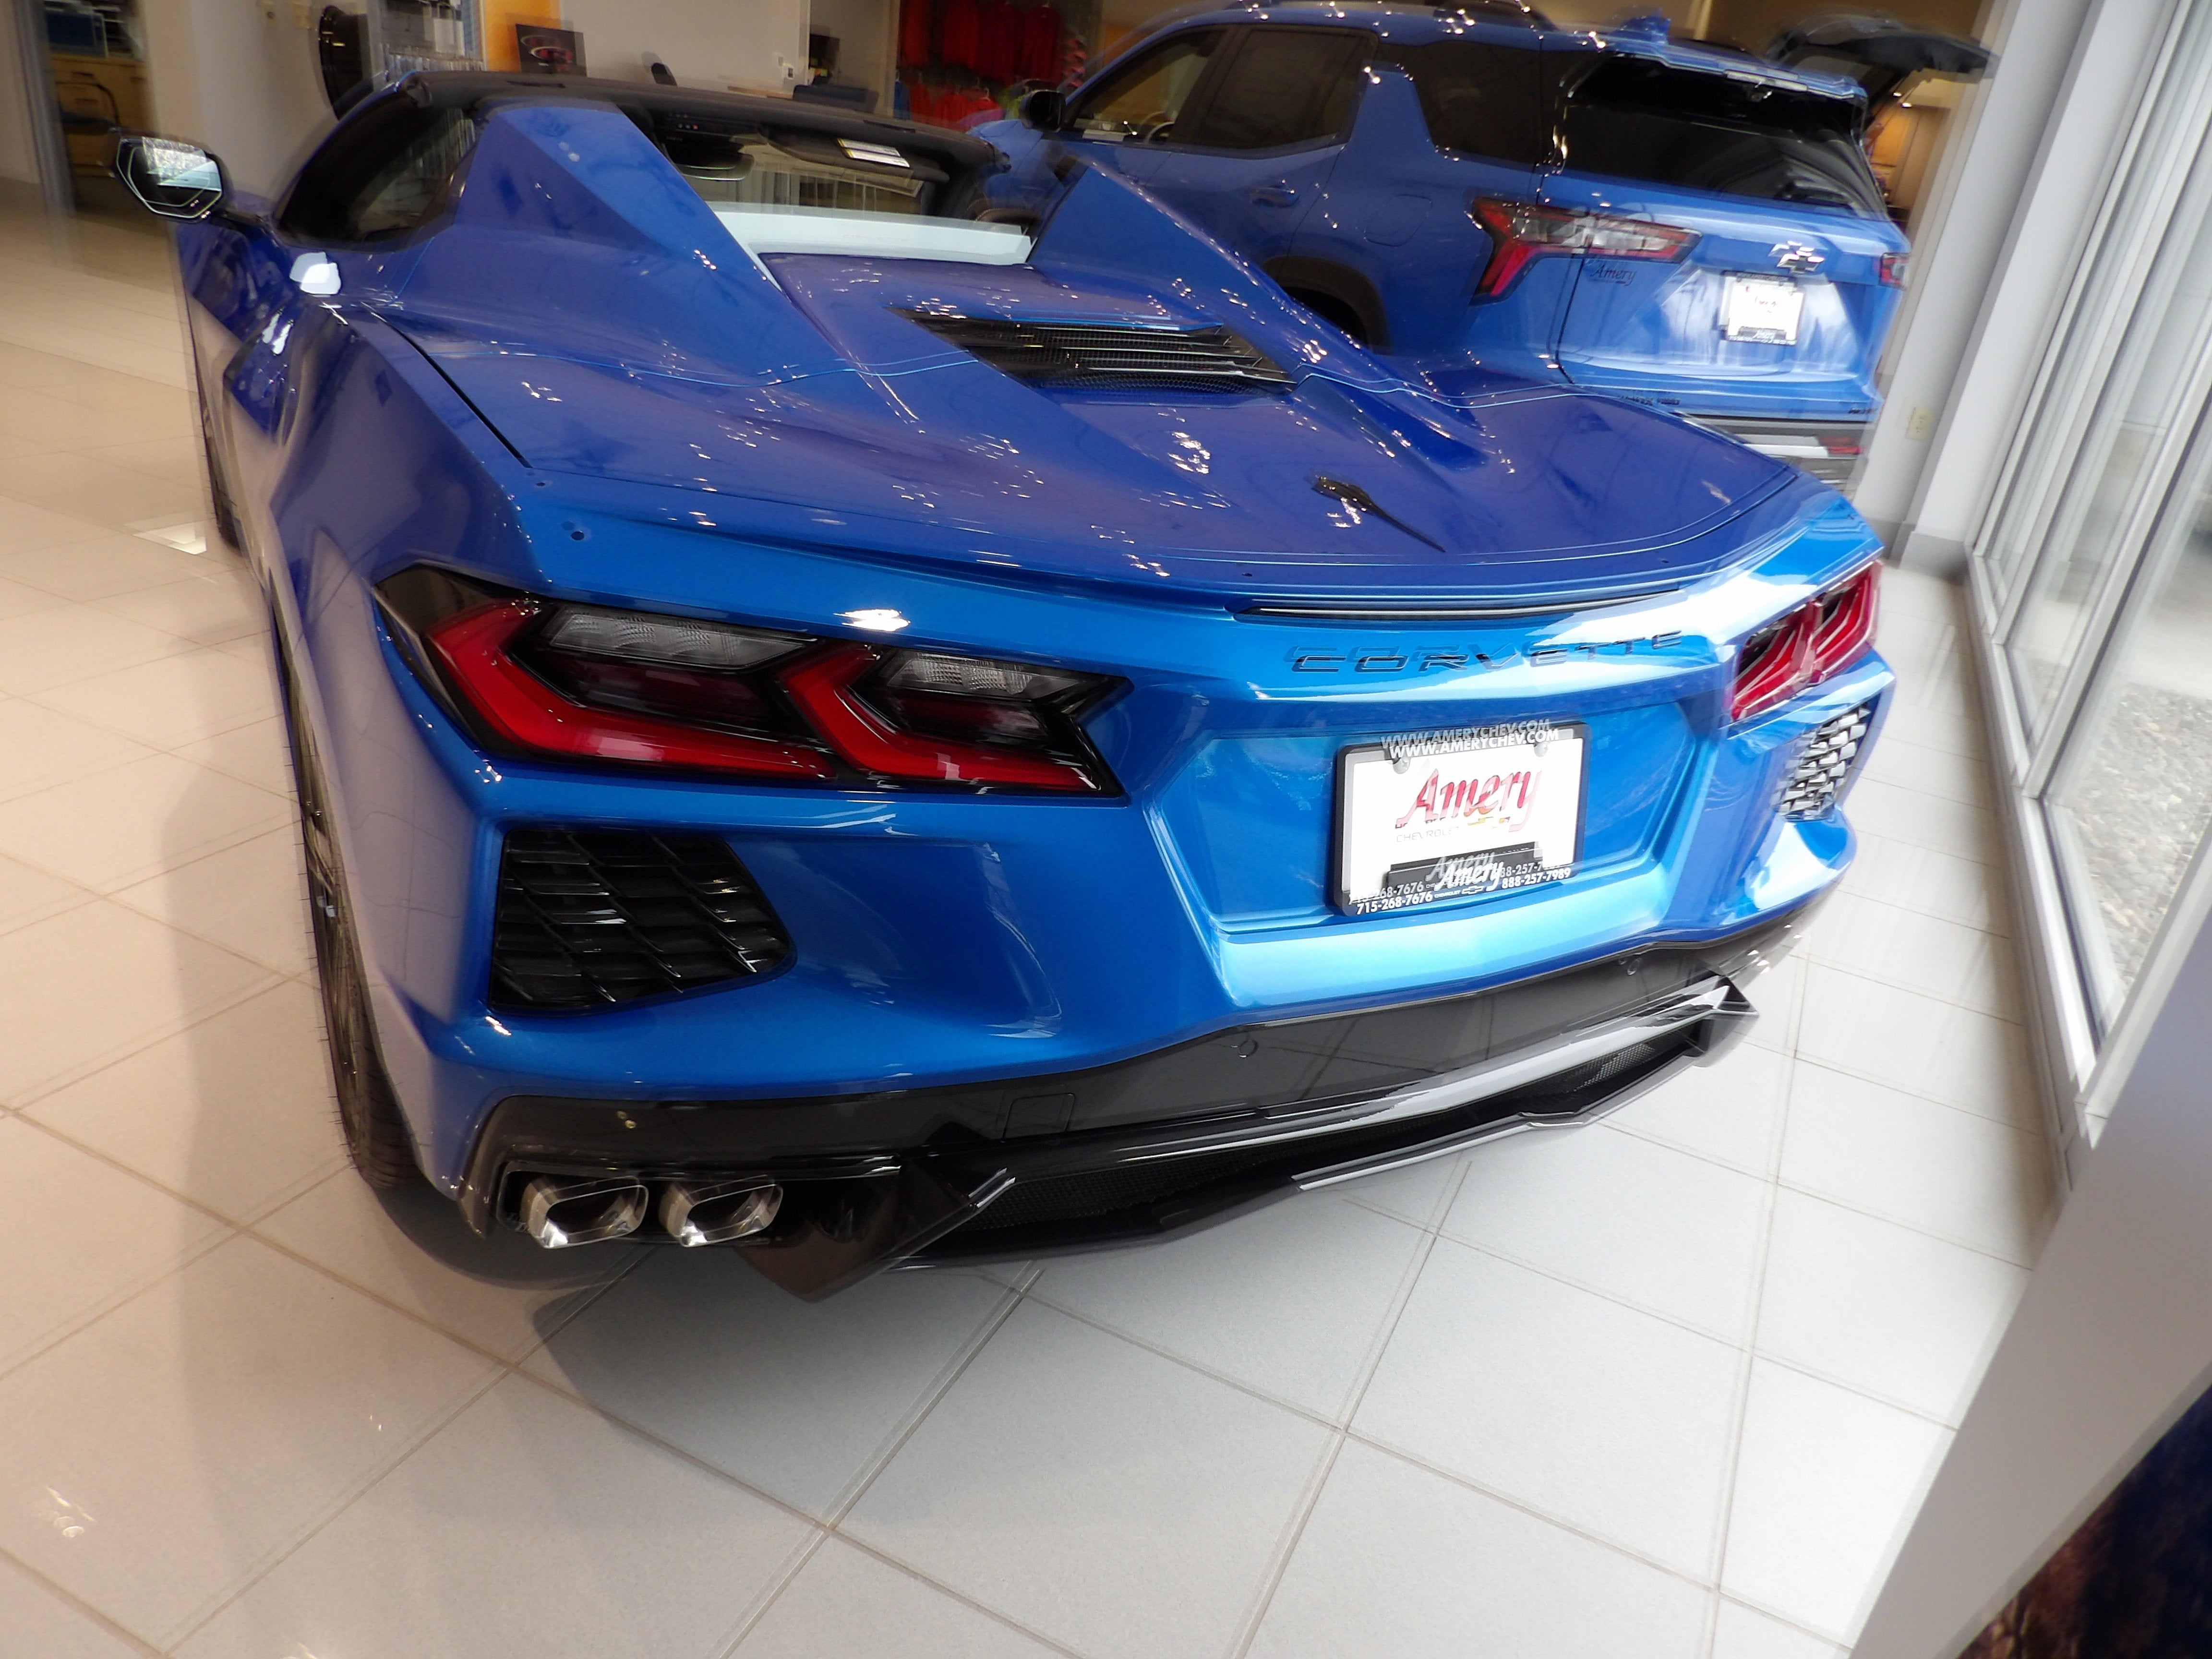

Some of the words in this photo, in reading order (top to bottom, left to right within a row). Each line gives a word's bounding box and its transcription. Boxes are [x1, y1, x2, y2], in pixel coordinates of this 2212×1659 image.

[1590, 264, 1637, 286] Amery
[1292, 629, 1683, 673] CORVETTE
[1389, 729, 1559, 759] WWW.AMERYCHEV.COM
[1395, 769, 1542, 832] Amery
[1357, 891, 1433, 915] 715-268-7676
[1501, 867, 1572, 889] 888-257-7989
[1434, 862, 1504, 892] Amery
